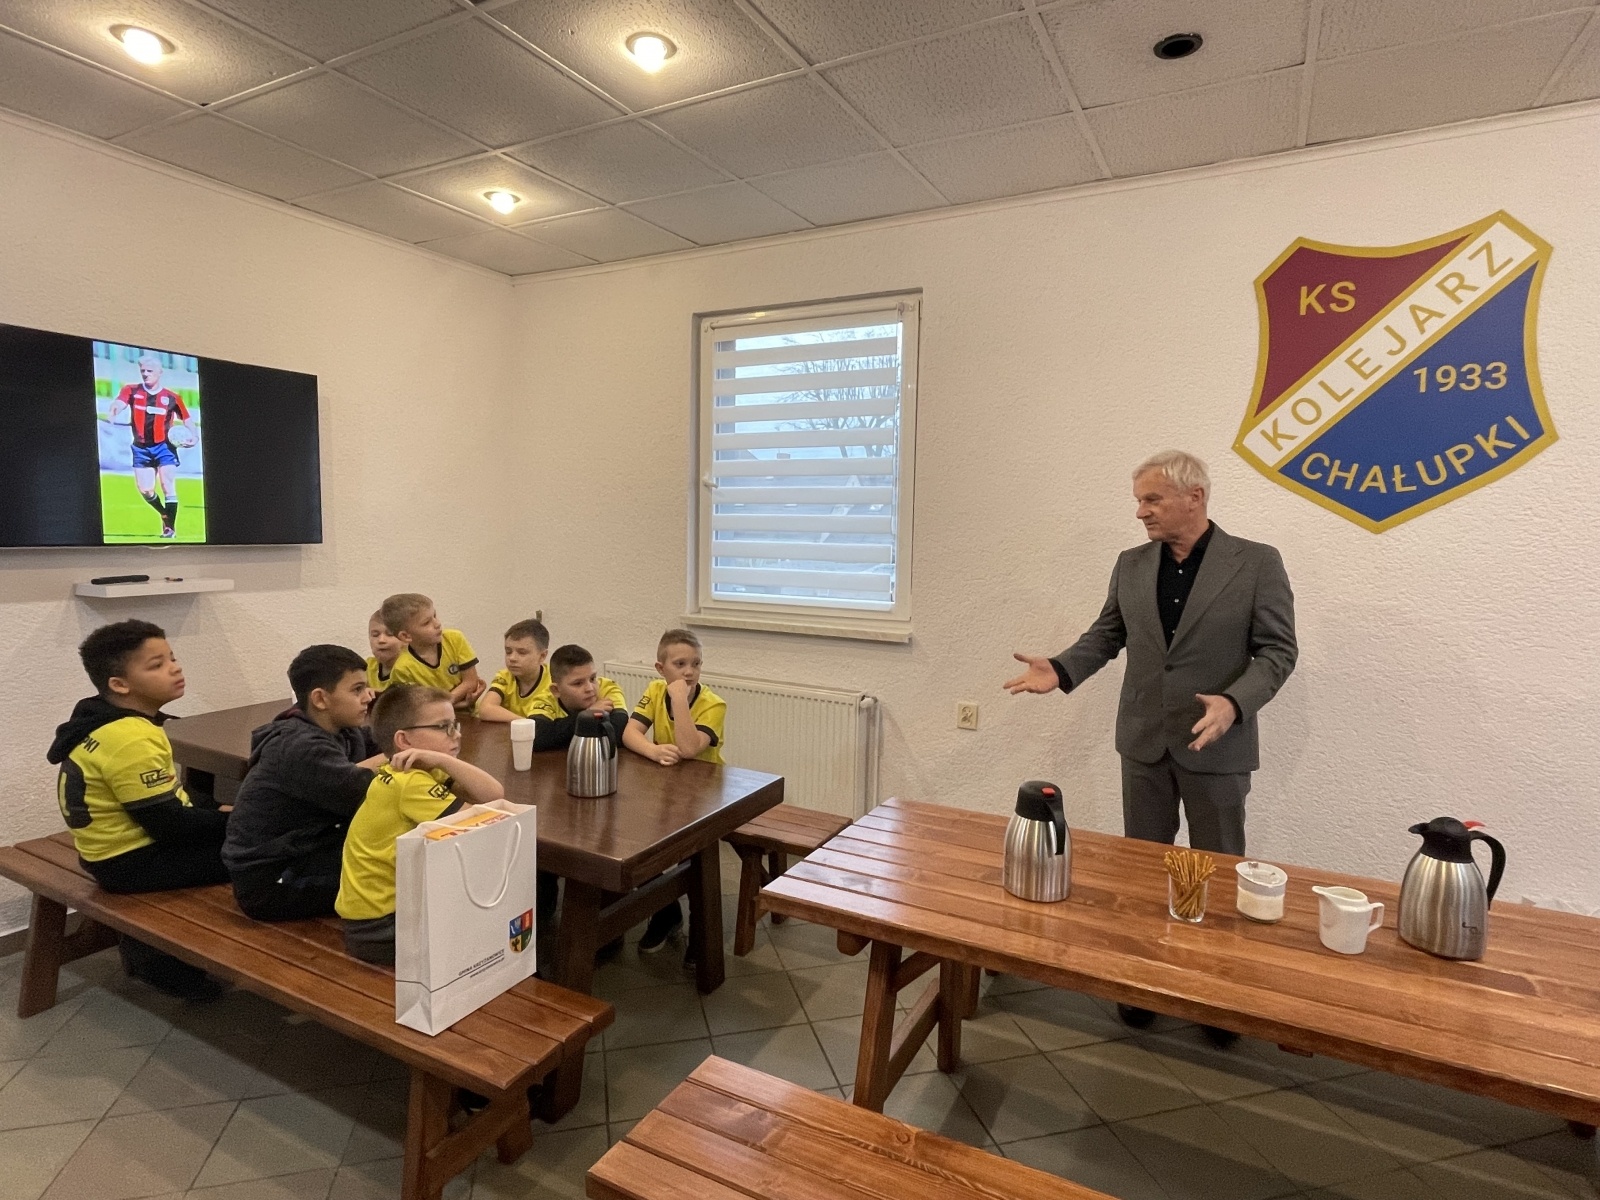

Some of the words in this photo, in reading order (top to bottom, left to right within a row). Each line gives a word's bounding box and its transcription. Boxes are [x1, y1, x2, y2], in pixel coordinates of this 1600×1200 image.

[1299, 281, 1357, 316] KS
[1260, 240, 1514, 452] KOLEJARZ
[1413, 361, 1509, 393] 1933
[1301, 414, 1531, 494] CHAŁUPKI
